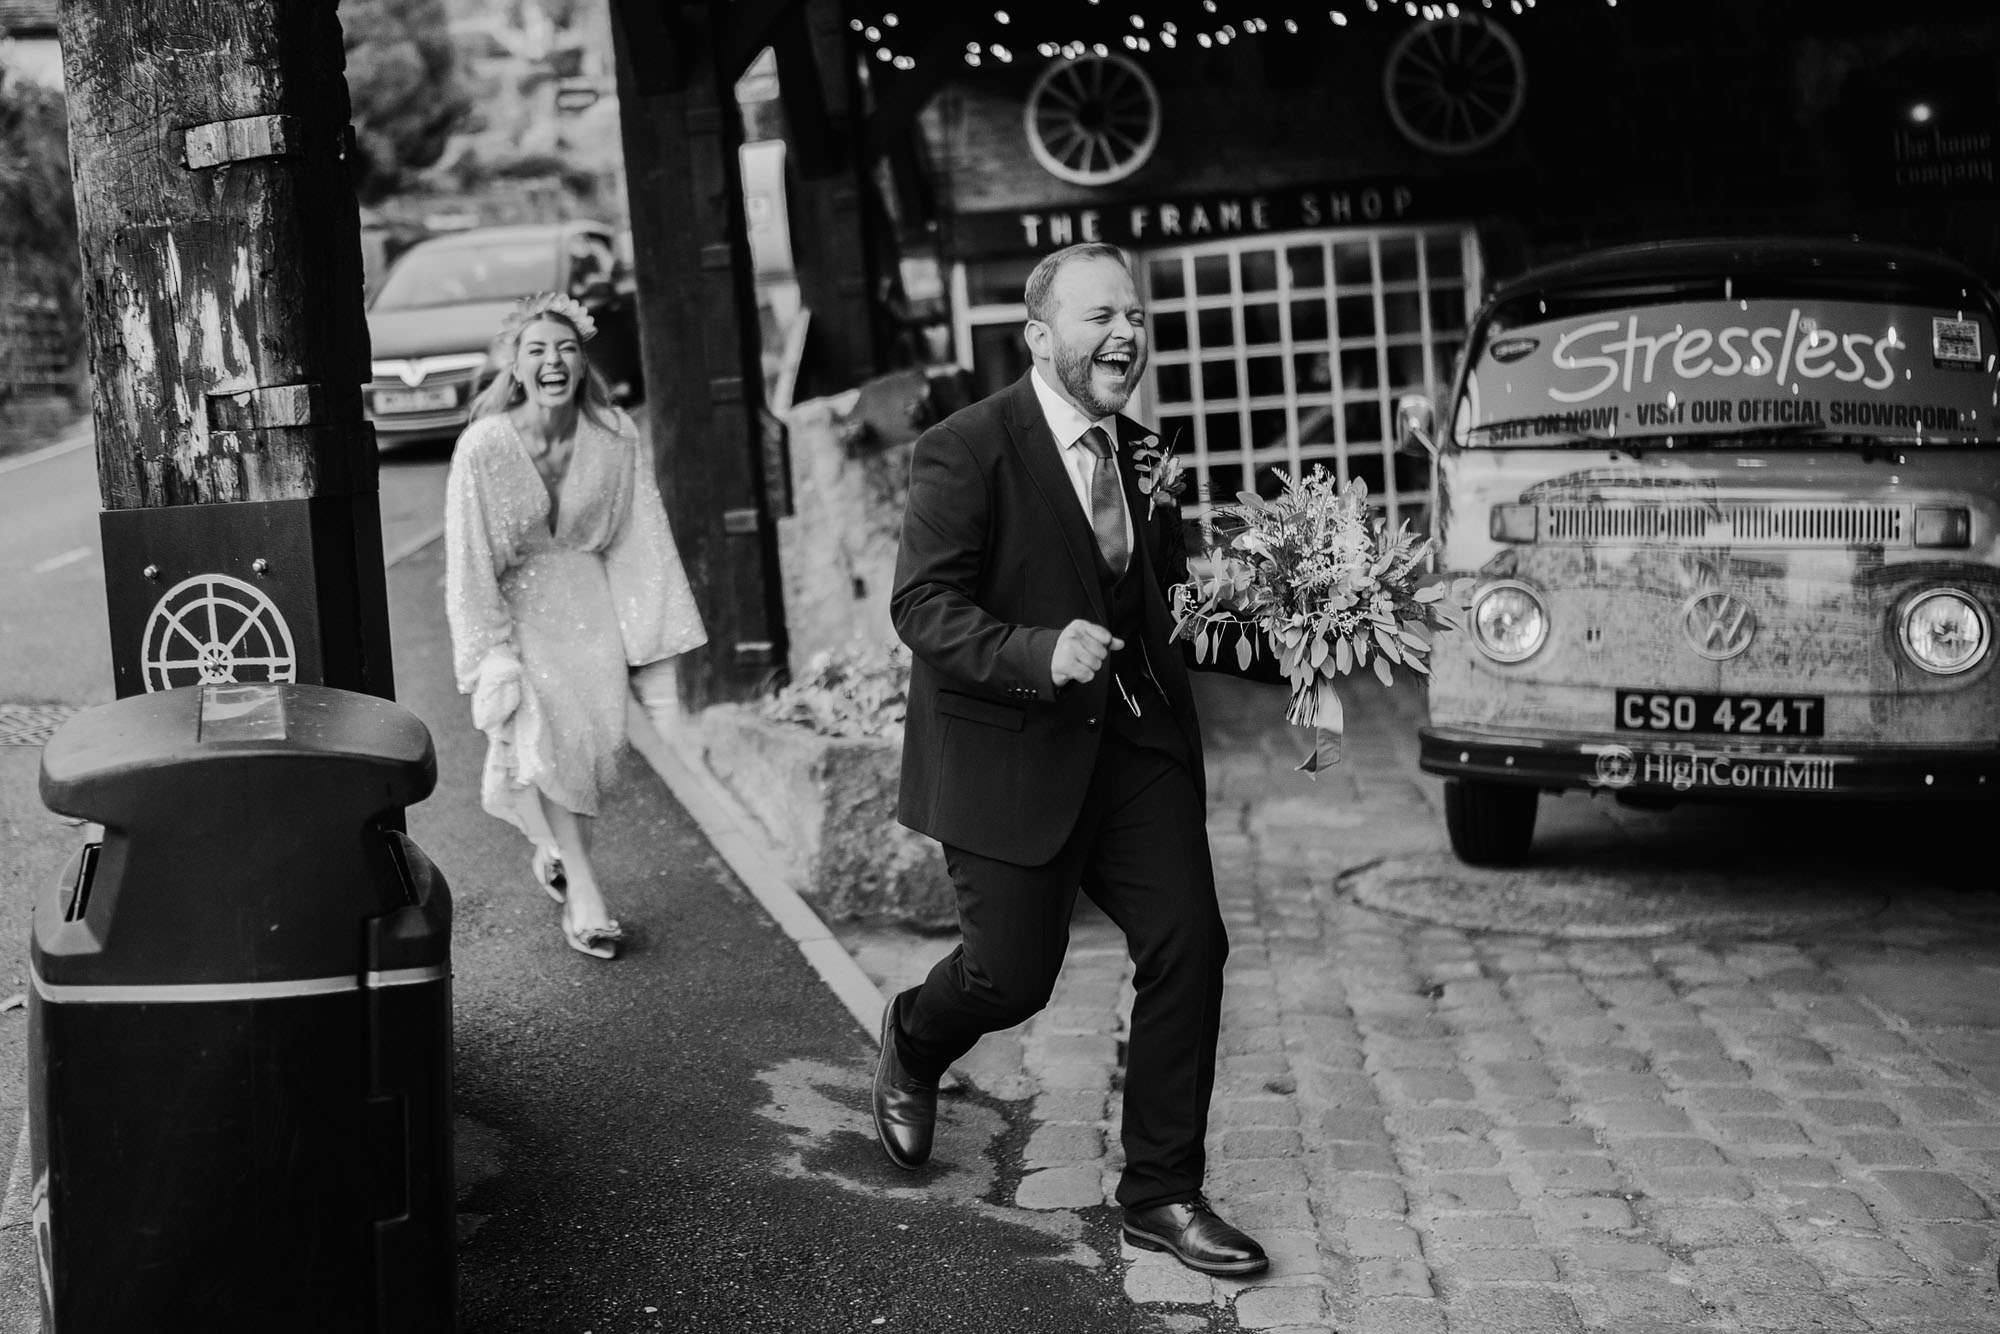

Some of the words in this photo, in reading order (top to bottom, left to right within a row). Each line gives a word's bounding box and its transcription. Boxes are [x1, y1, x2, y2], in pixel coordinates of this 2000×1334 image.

[1892, 127, 1928, 161] the
[1895, 157, 1993, 190] company
[1019, 209, 1104, 247] THE
[1130, 196, 1273, 239] FRAME
[1300, 185, 1413, 225] SHOP
[1547, 307, 1906, 403] Stressless
[1636, 402, 1685, 427] VISIT
[1690, 400, 1733, 425] OUR
[1738, 398, 1824, 425] OFFICIAL
[1622, 693, 1697, 729] CSO
[1712, 697, 1815, 734] 424T
[1643, 753, 1836, 791] HighCornMill
